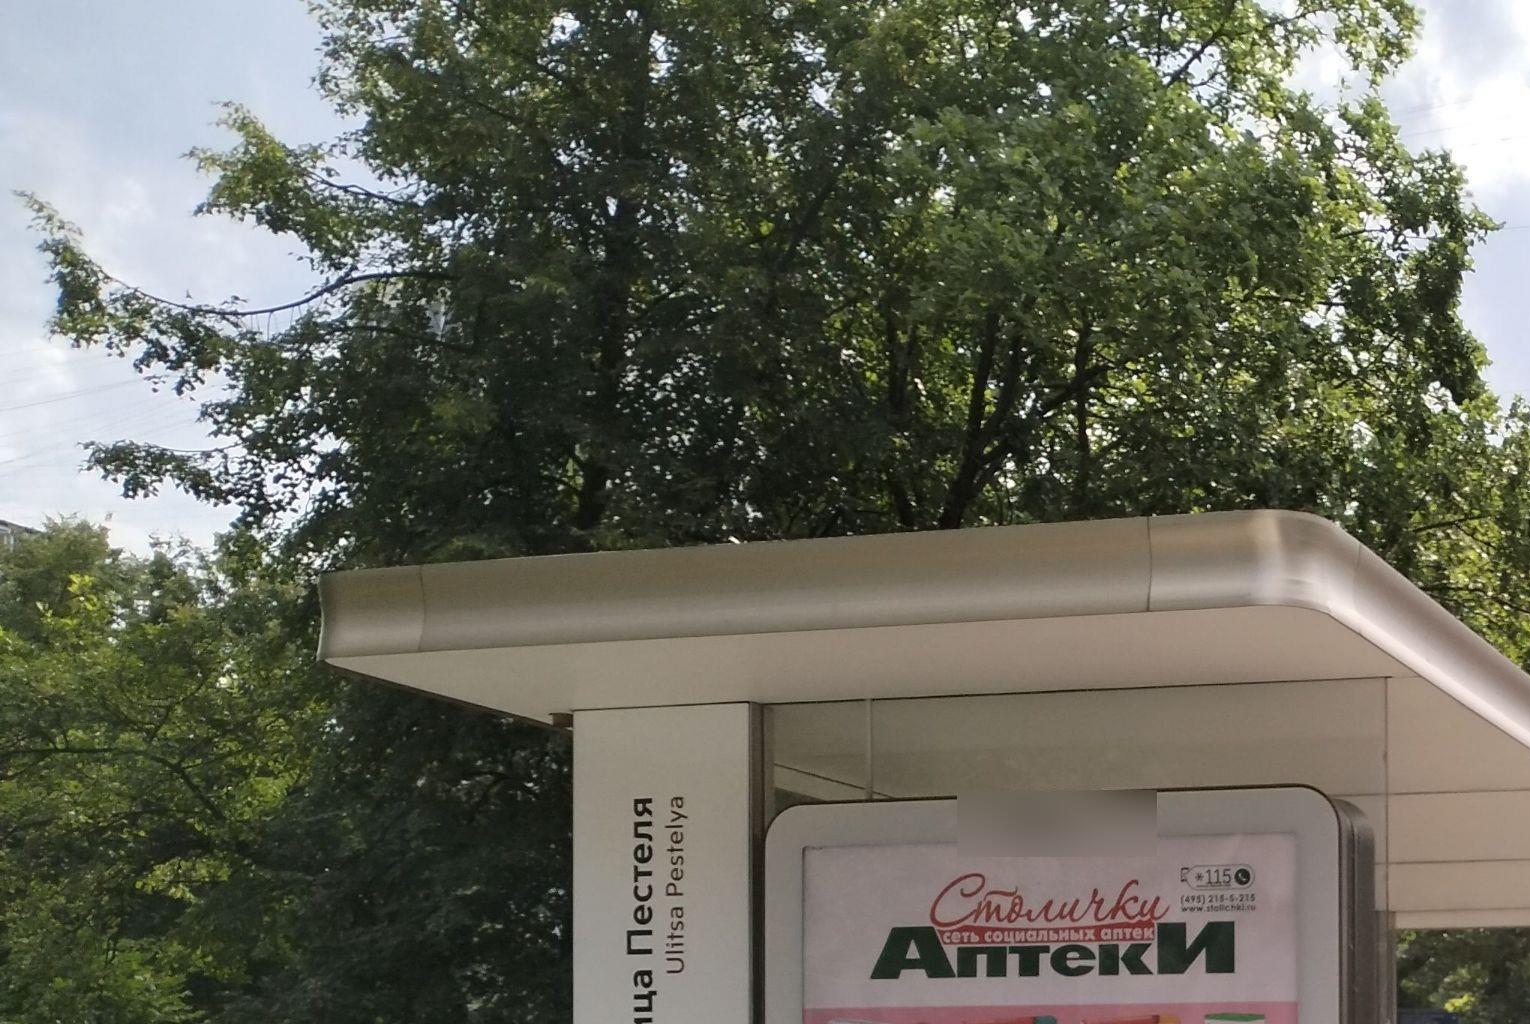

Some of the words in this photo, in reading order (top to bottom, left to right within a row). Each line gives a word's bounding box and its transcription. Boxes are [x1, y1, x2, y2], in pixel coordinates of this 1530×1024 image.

[626, 797, 653, 955] Пестеля
[664, 795, 688, 897] Pestelya
[929, 872, 1172, 929] Столички
[943, 930, 980, 944] сеть
[985, 927, 1096, 945] социальных
[1100, 925, 1154, 944] аптек
[665, 905, 685, 975] Ulitsa
